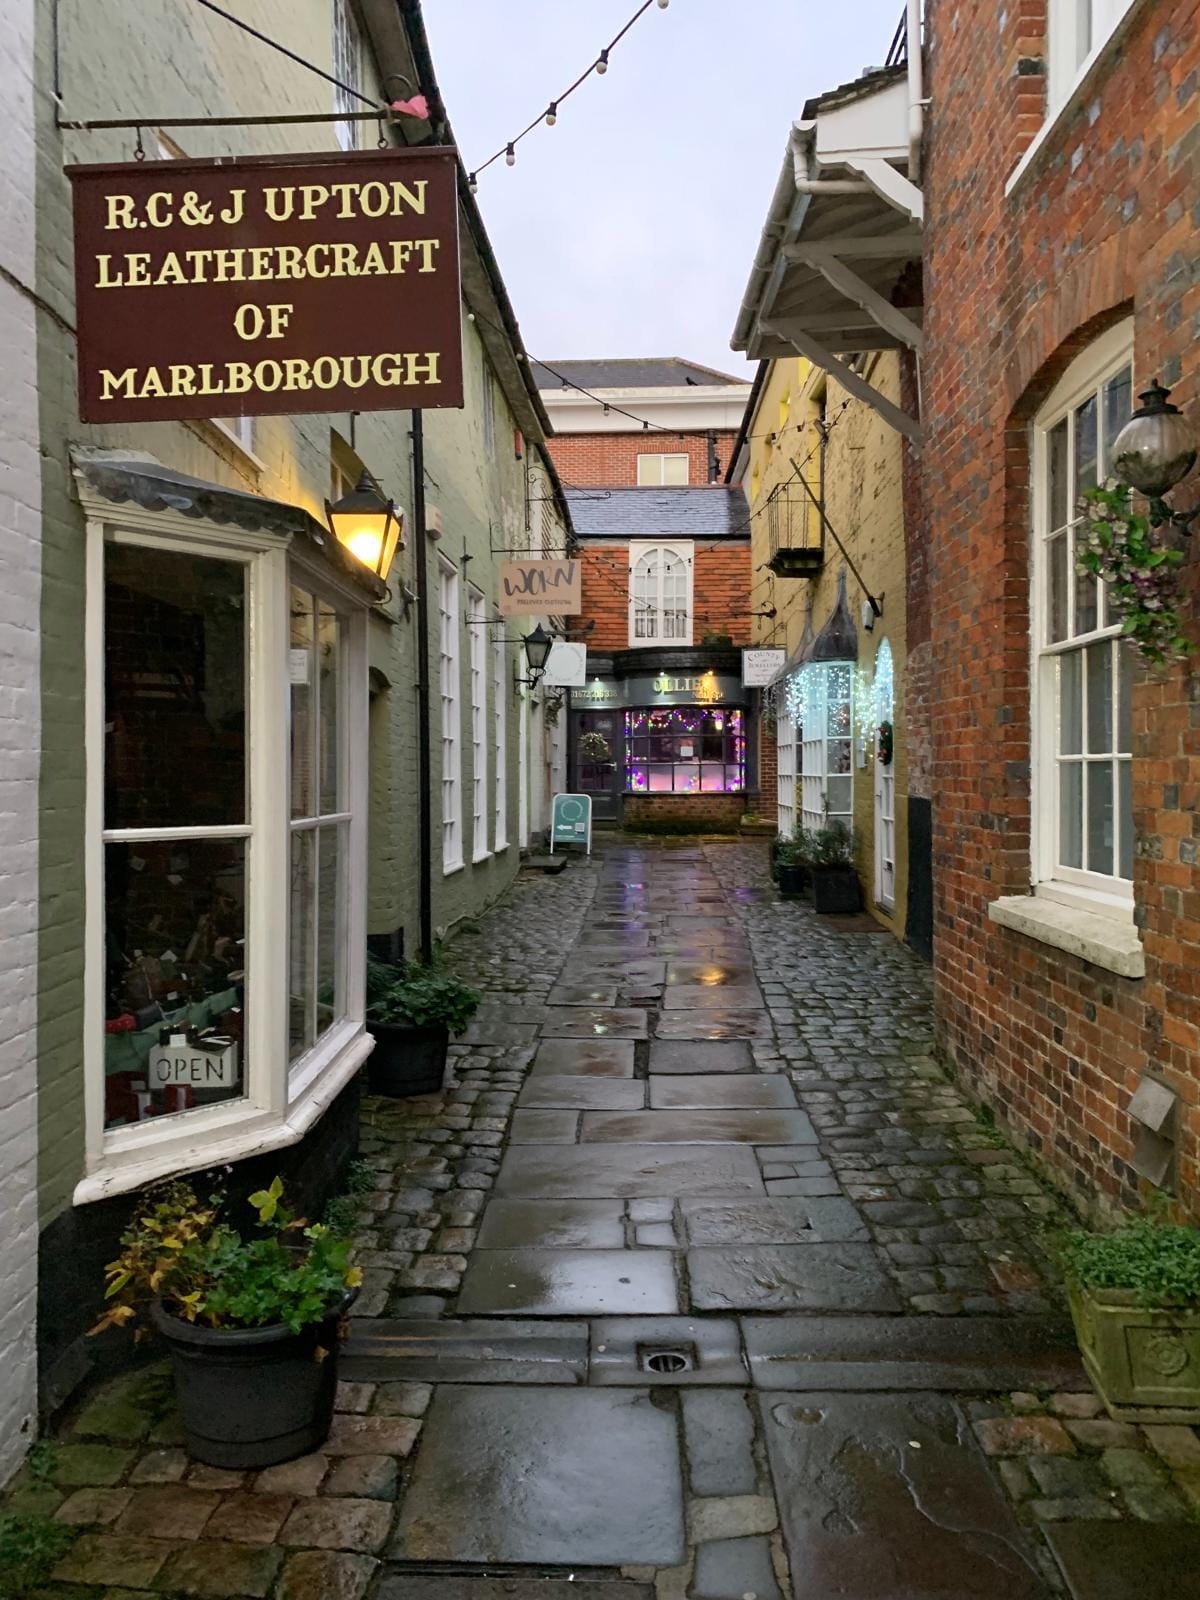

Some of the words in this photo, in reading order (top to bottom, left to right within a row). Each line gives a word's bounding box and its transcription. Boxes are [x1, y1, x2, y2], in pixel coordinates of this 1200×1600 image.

[262, 180, 429, 223] UPTON
[94, 238, 440, 289] LEATHERCRAFT
[233, 303, 294, 341] OF
[98, 352, 442, 400] MARLBOROUGH
[503, 561, 575, 597] WORN
[156, 1058, 224, 1082] OPEN
